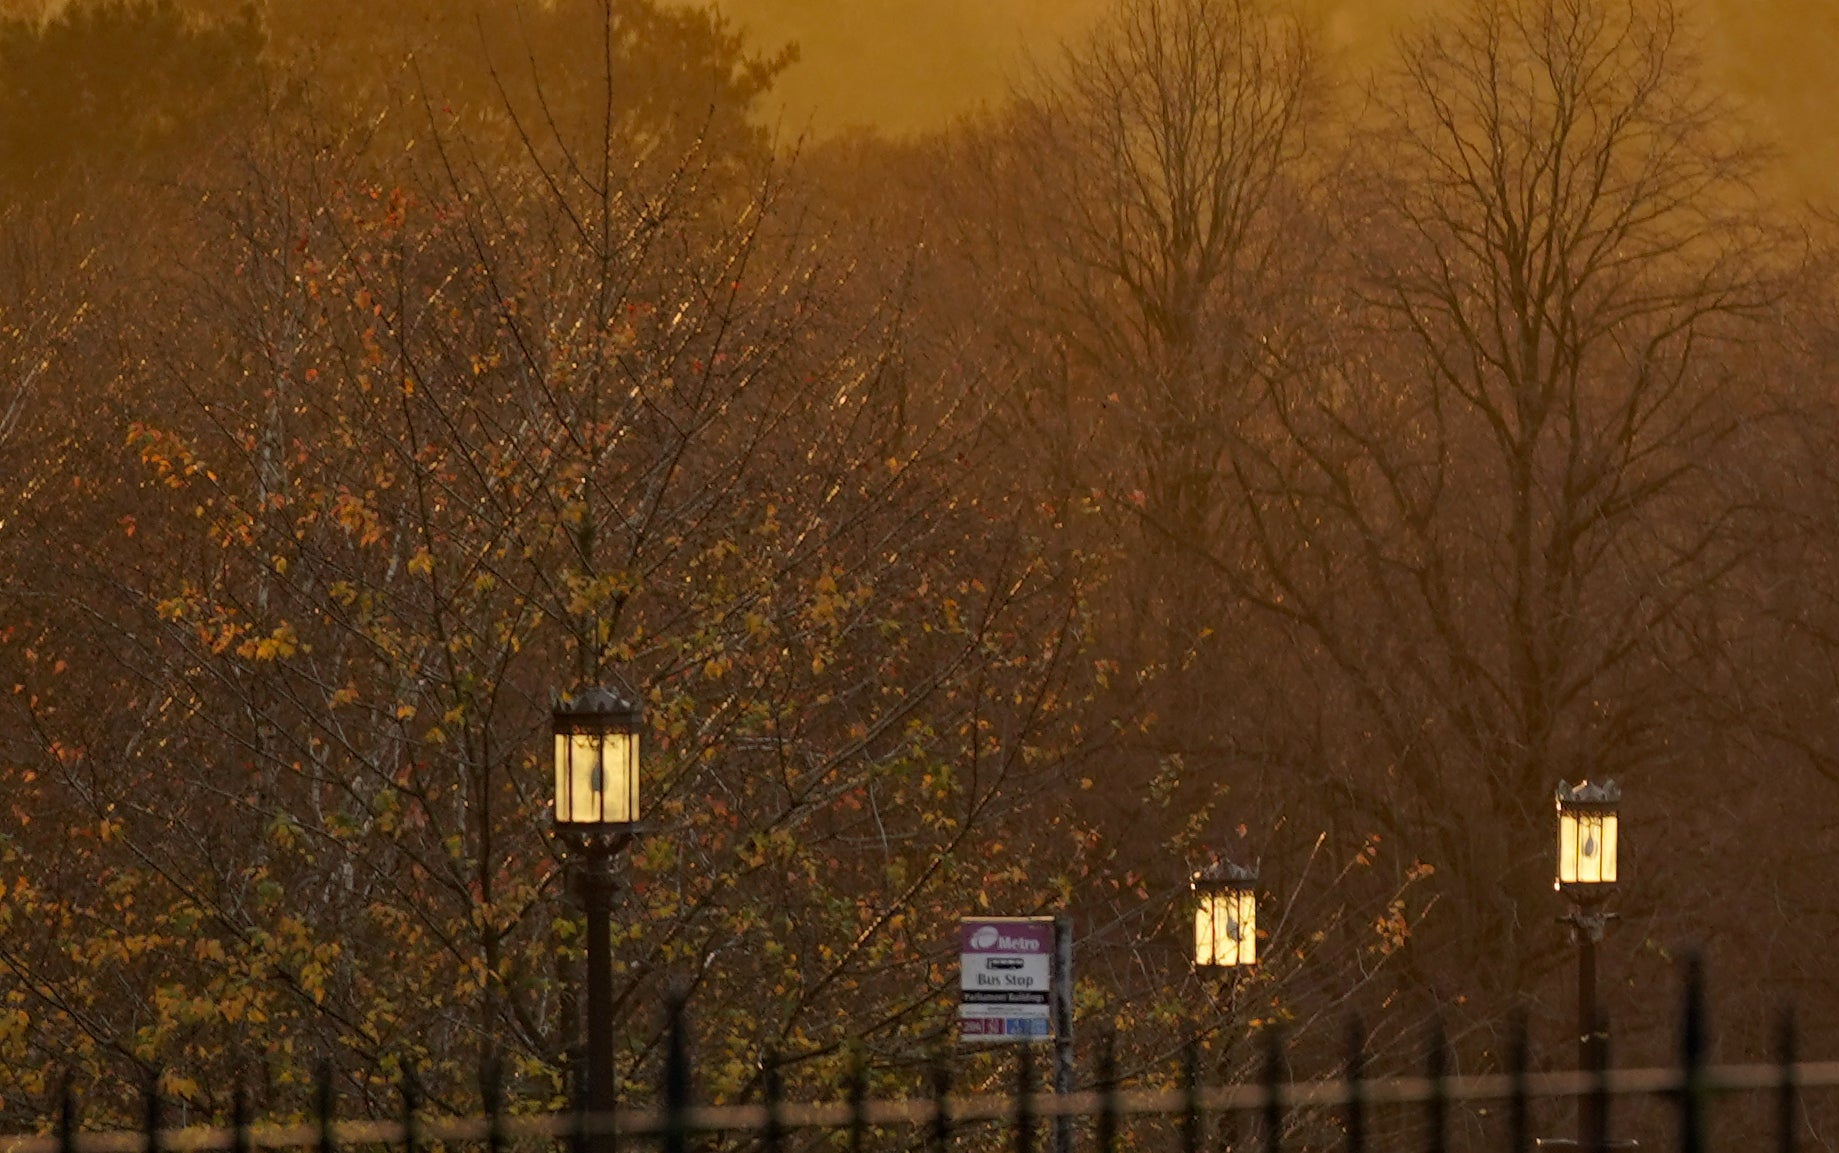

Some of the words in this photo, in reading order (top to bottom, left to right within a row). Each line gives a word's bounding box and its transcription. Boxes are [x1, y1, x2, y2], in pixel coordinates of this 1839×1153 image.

[998, 937, 1040, 950] Metro
[978, 974, 1001, 985] Bus
[1005, 974, 1034, 988] Stop
